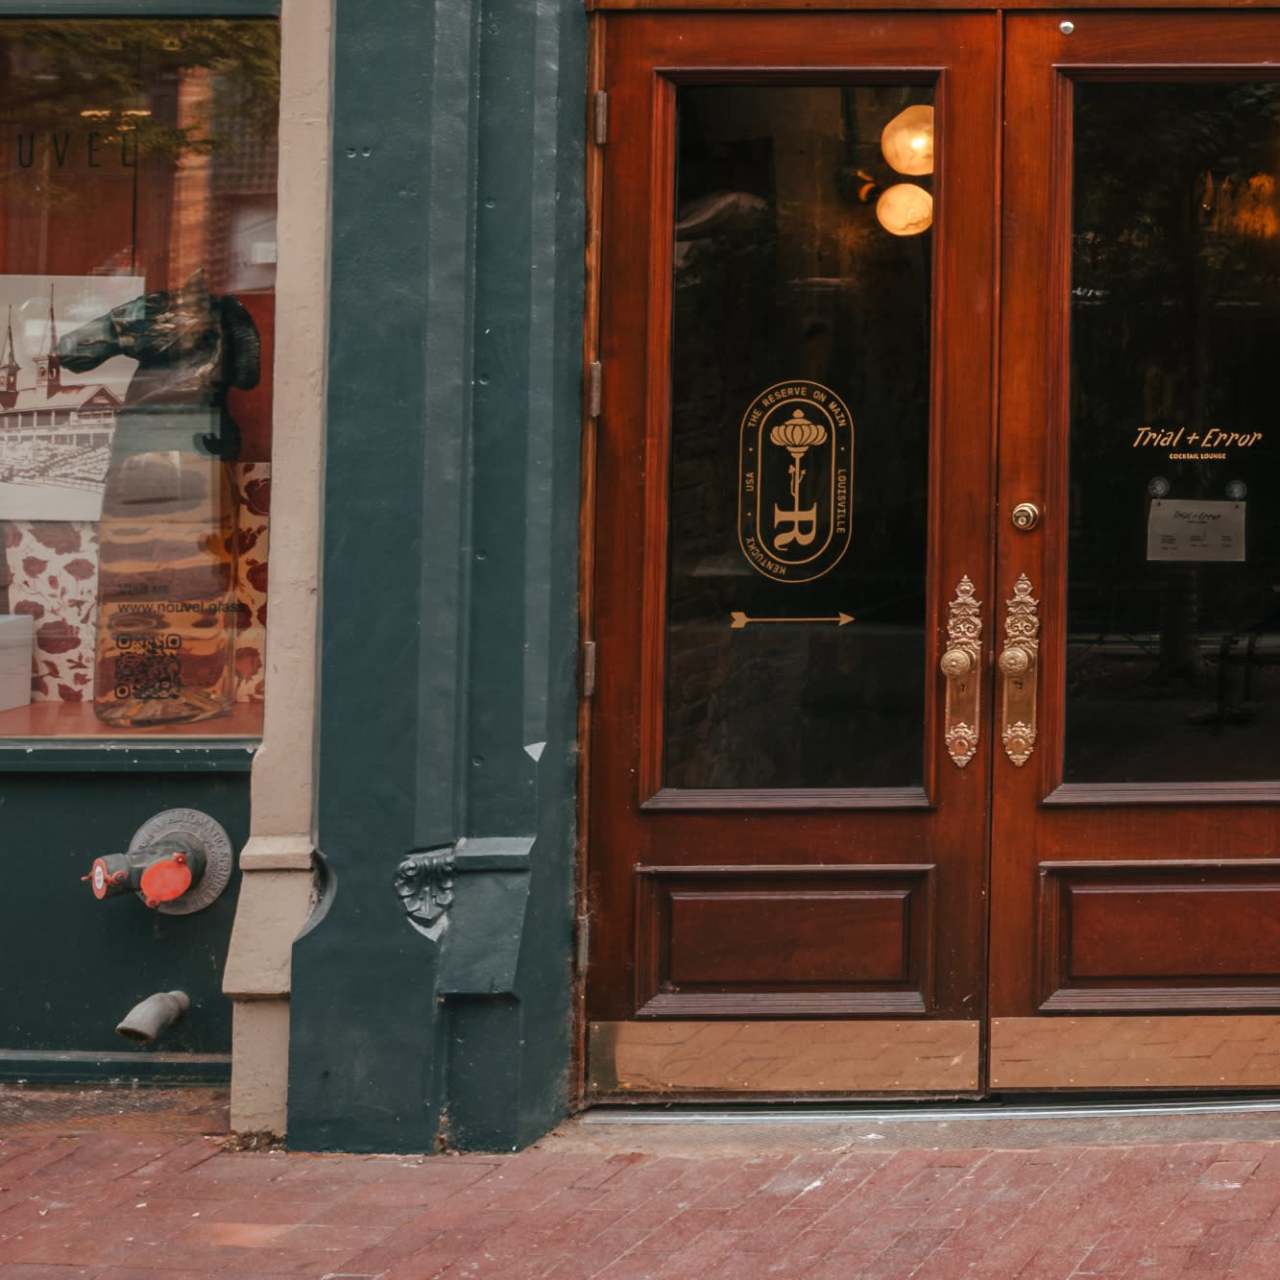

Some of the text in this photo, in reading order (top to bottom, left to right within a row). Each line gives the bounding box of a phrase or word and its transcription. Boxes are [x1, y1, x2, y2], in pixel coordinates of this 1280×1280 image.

[747, 386, 847, 428] THE RESERVE ON MAIN
[1132, 426, 1185, 448] Trial
[1201, 428, 1263, 448] Error
[745, 471, 755, 492] USA
[836, 468, 847, 534] LOUISVILLE
[745, 535, 786, 575] KENTUCKY
